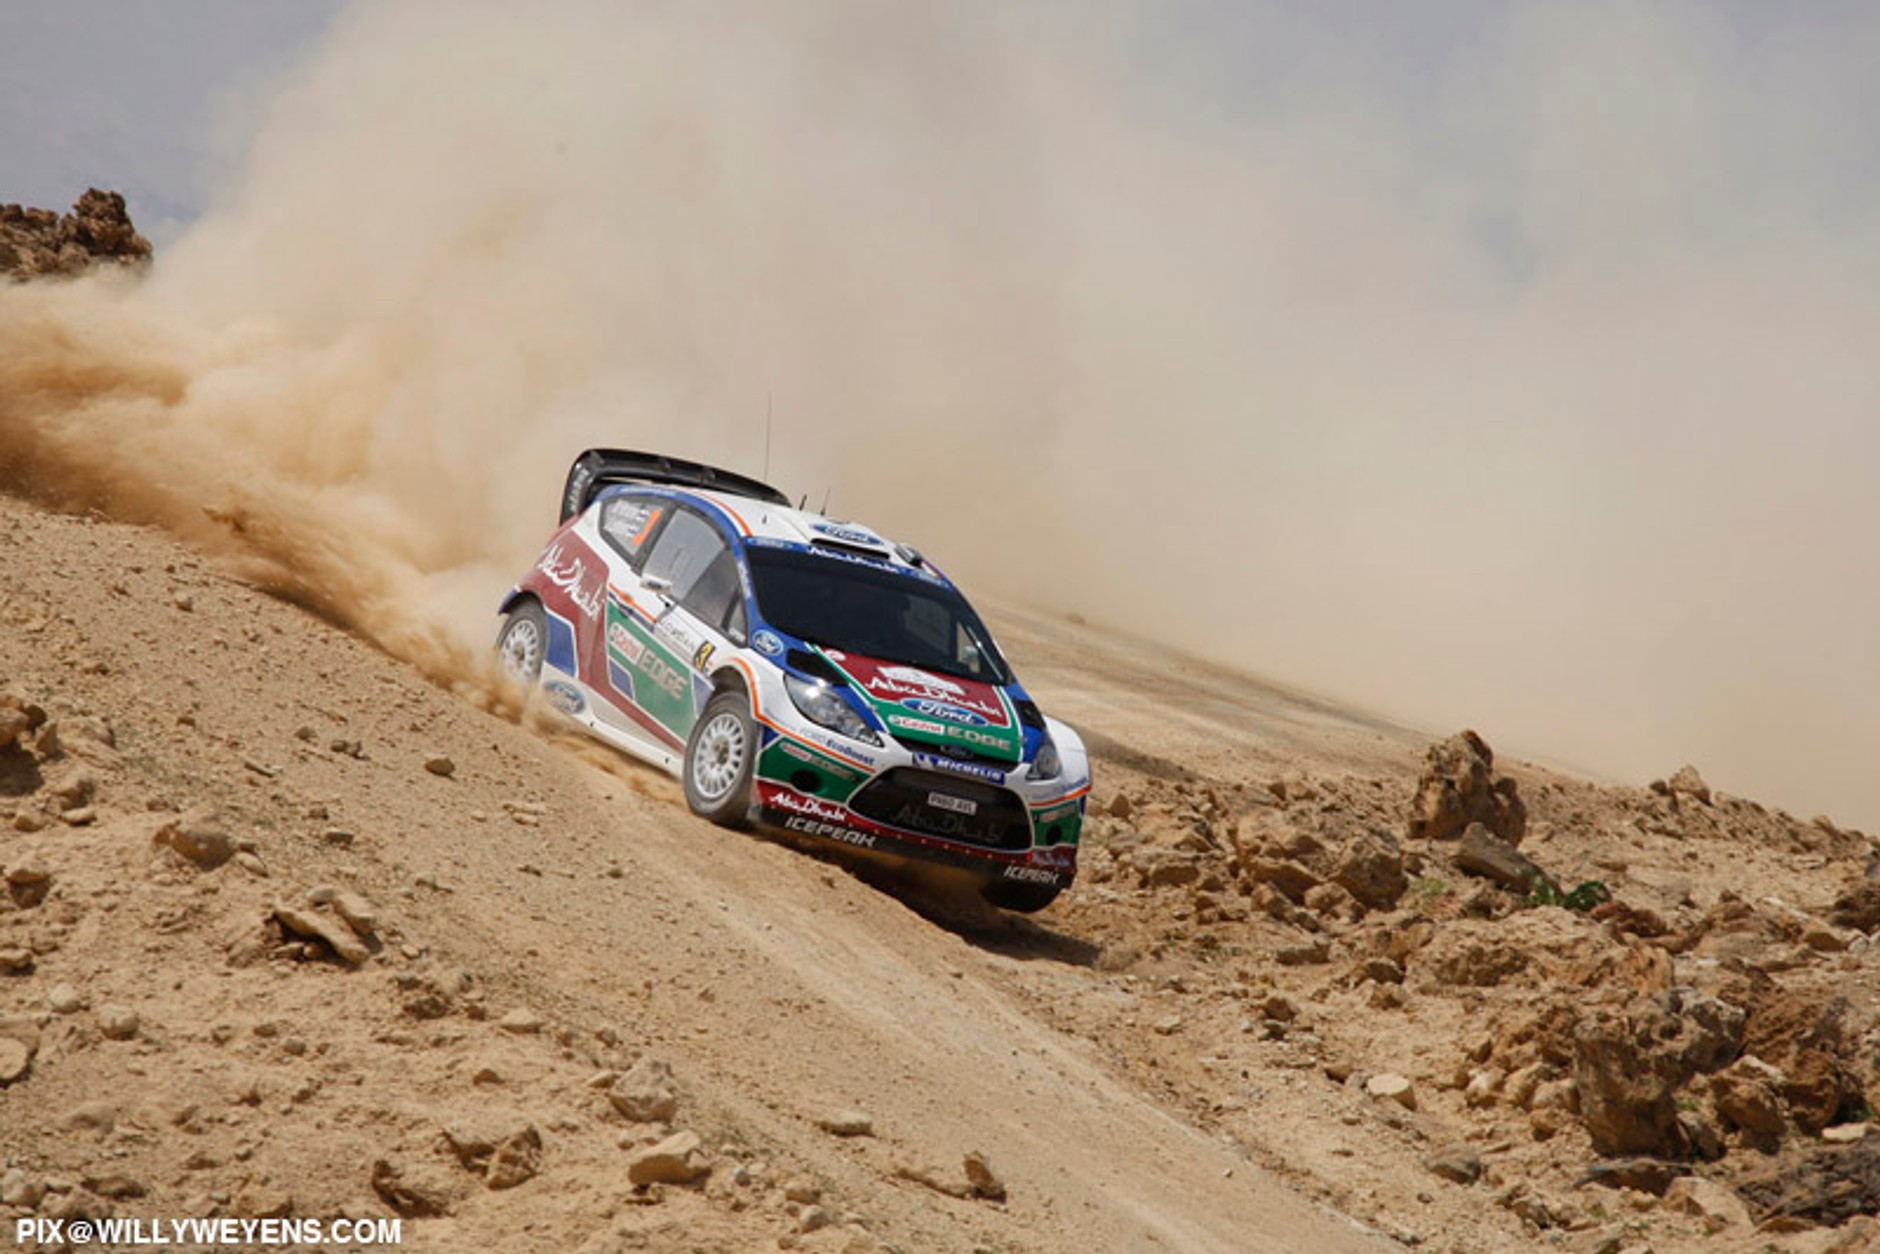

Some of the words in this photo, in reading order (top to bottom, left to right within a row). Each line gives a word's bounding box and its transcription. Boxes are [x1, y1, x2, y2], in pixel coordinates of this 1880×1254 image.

[638, 648, 688, 701] EDGE
[918, 701, 976, 724] Ford
[901, 718, 943, 734] Castrol
[946, 725, 1012, 751] EDGE
[937, 758, 1002, 781] MICHELIN
[784, 816, 877, 848] ICEPEAK
[1003, 864, 1060, 885] ICEPEAK
